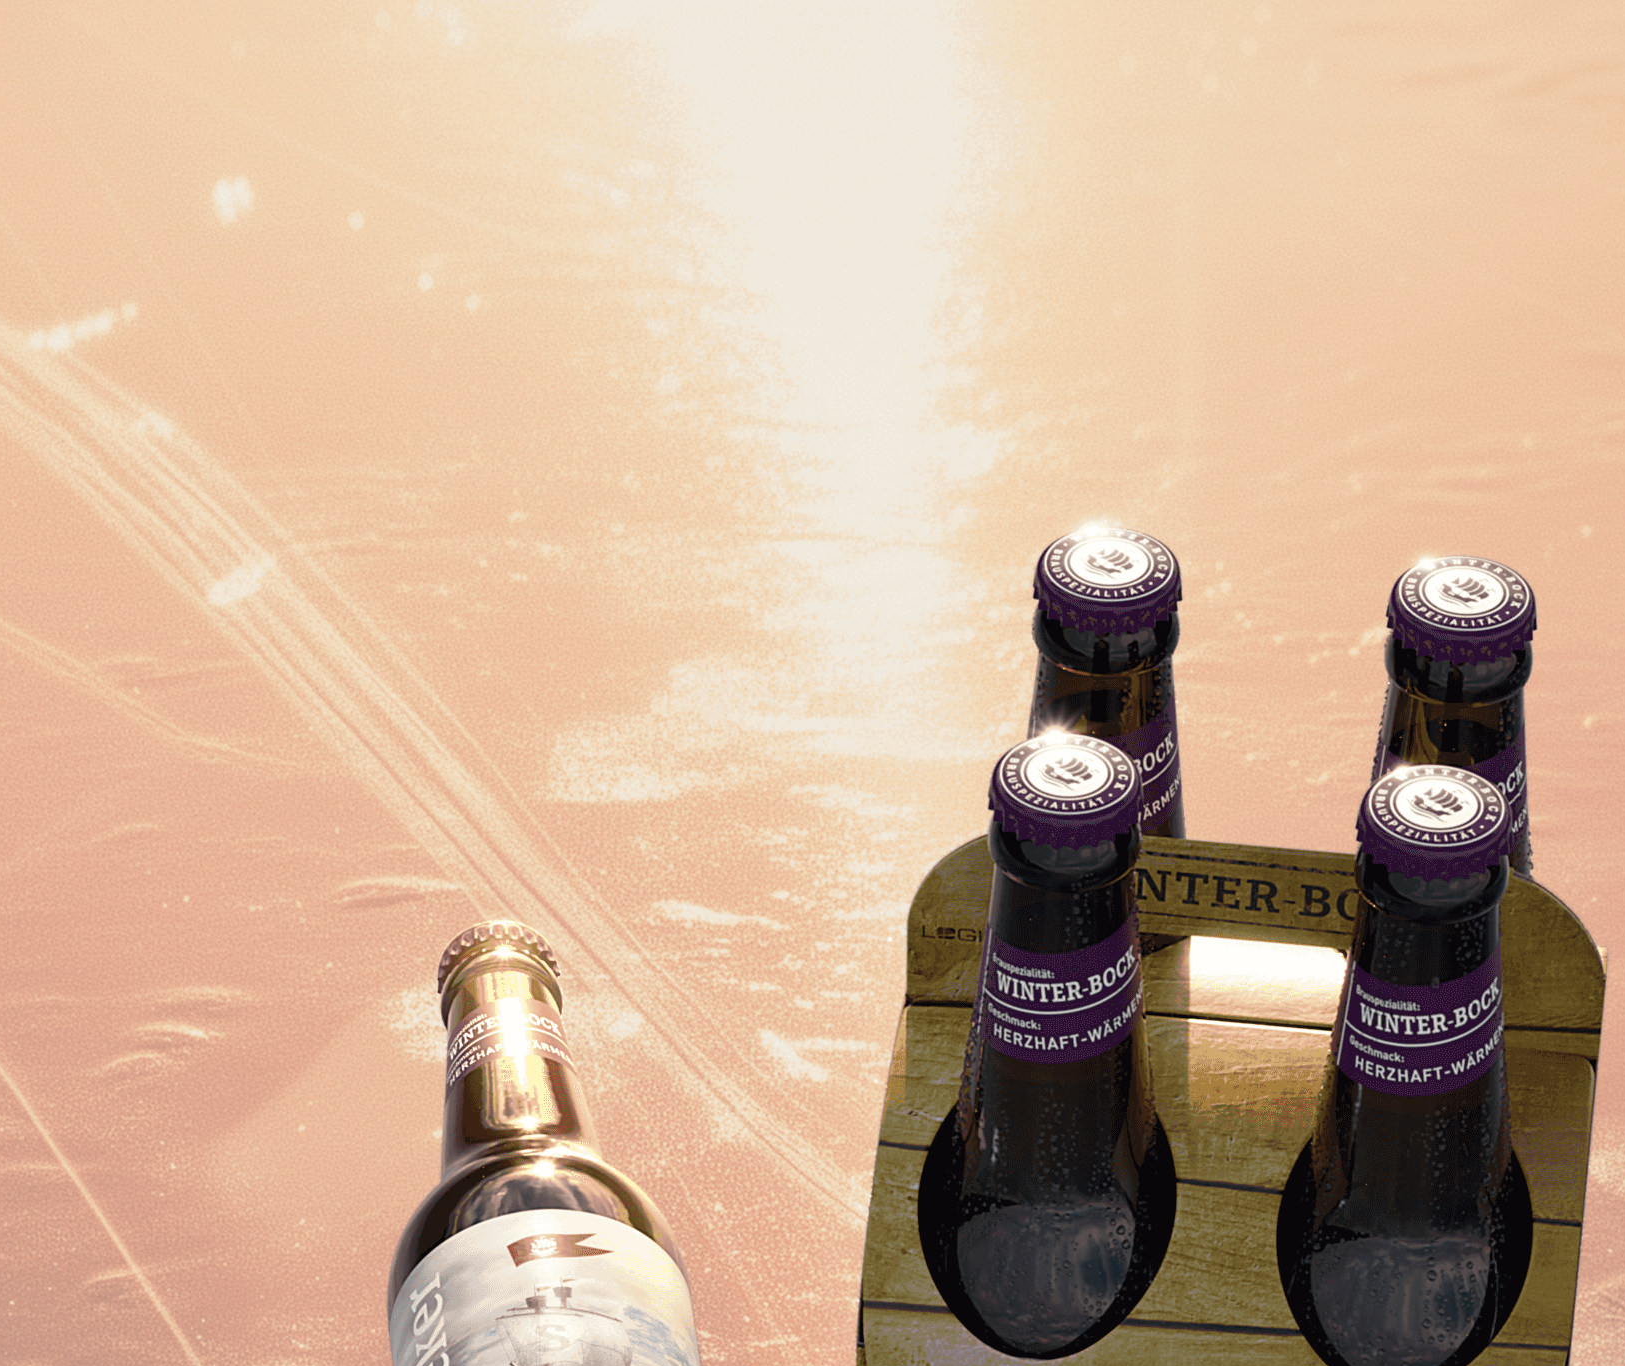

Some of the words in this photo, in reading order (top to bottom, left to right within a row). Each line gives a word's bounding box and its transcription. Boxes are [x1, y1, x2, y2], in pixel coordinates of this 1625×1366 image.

[1050, 548, 1145, 598] BRAUSPEZIALITÄT
[1403, 576, 1503, 627] BRAUSPEZIALITÄT
[1005, 756, 1105, 811] BRAUSPEZIALITÄT
[1374, 787, 1477, 843] BRAUSPEZIALITÄT
[992, 952, 1055, 980] Brauspezialität:
[996, 944, 1135, 1003] WINTER-BOCK
[987, 1002, 1041, 1030] Geschmack:
[1355, 983, 1421, 1012] Brauspezialität:
[1360, 976, 1500, 1036] WINTER-BOCK
[1349, 1034, 1405, 1063] Geschmack:
